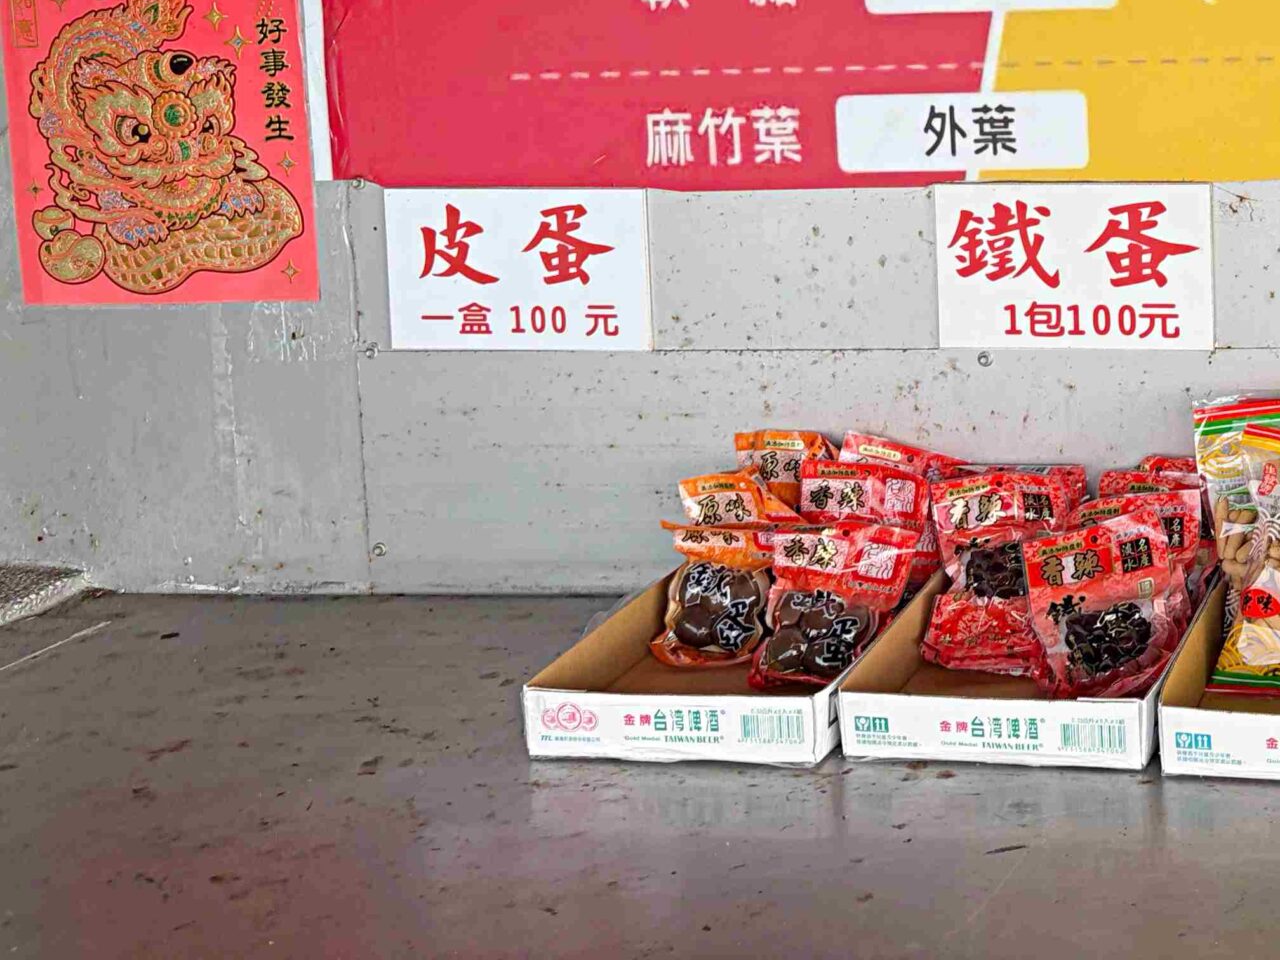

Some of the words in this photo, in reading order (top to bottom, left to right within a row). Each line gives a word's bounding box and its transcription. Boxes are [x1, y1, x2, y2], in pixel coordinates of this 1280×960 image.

[256, 18, 295, 141] 好事發生
[646, 106, 803, 168] 麻竹葉
[923, 104, 1018, 158] 外葉
[419, 203, 615, 286] 皮蛋
[947, 199, 1199, 288] 鐵蛋
[1003, 302, 1181, 339] 1包100元
[810, 480, 866, 512] 香辣
[1042, 549, 1104, 587] 香辣
